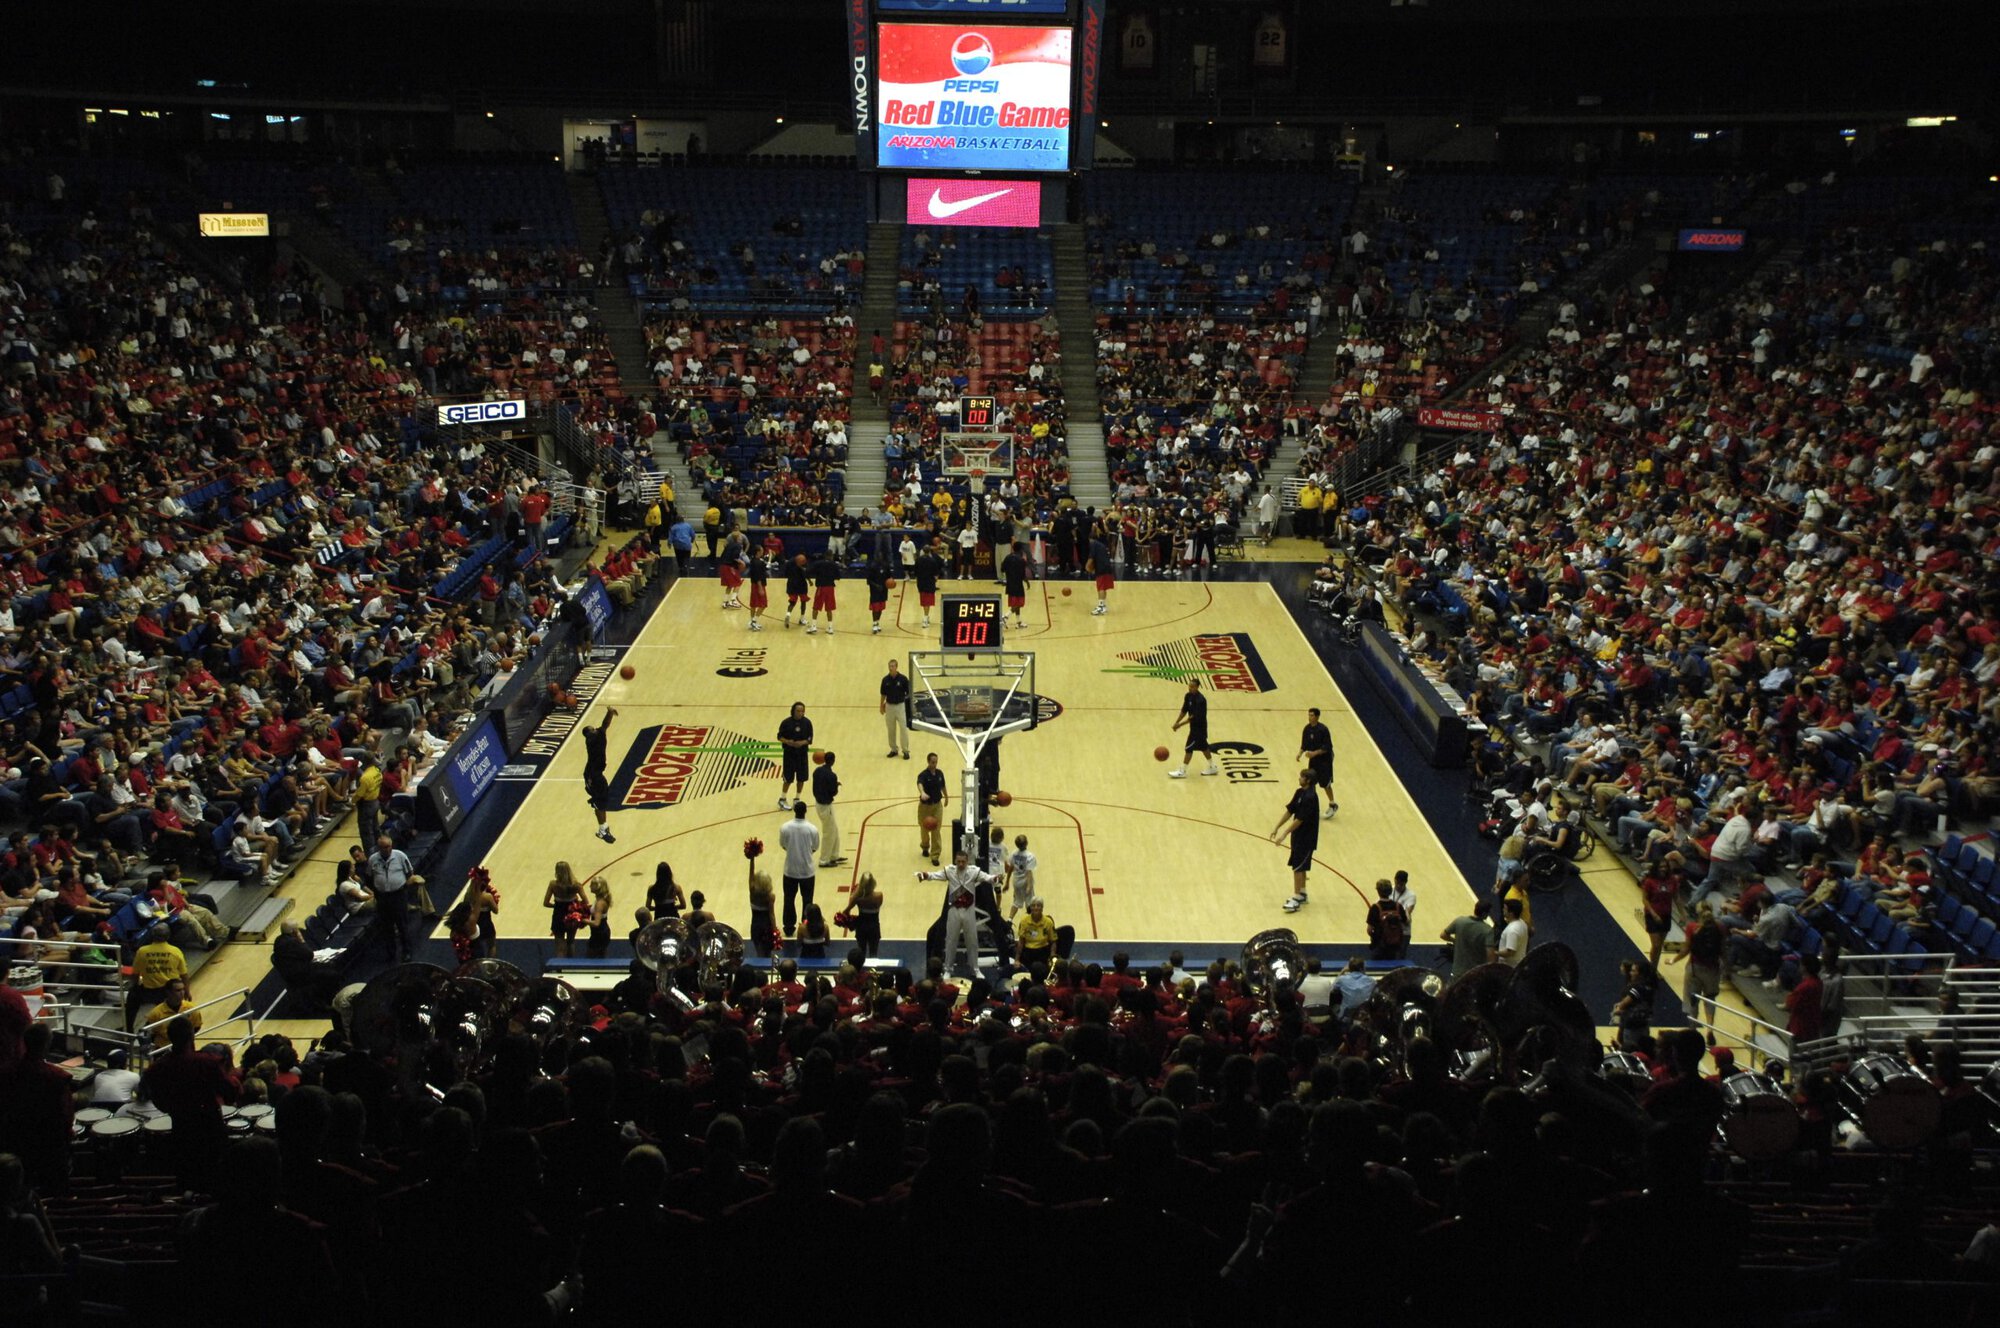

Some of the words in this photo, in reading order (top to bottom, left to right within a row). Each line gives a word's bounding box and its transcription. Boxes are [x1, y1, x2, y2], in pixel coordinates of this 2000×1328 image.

[1130, 35, 1146, 49] 10
[1259, 31, 1281, 46] 22
[944, 80, 999, 93] PEPSI
[884, 100, 934, 125] Red
[937, 100, 995, 127] Blue
[997, 102, 1070, 128] Game
[887, 136, 956, 149] ARIZONA
[956, 137, 1061, 151] BASKETBALL
[1687, 233, 1743, 245] ARIZONA
[970, 399, 991, 408] 8:42
[447, 402, 518, 422] GEICO
[968, 410, 987, 423] 00
[1442, 411, 1460, 419] What
[1461, 413, 1476, 421] else
[959, 603, 995, 617] 8:42
[956, 622, 987, 645] 00
[1194, 635, 1259, 692] ARIZONA
[623, 725, 712, 804] ARIZONA
